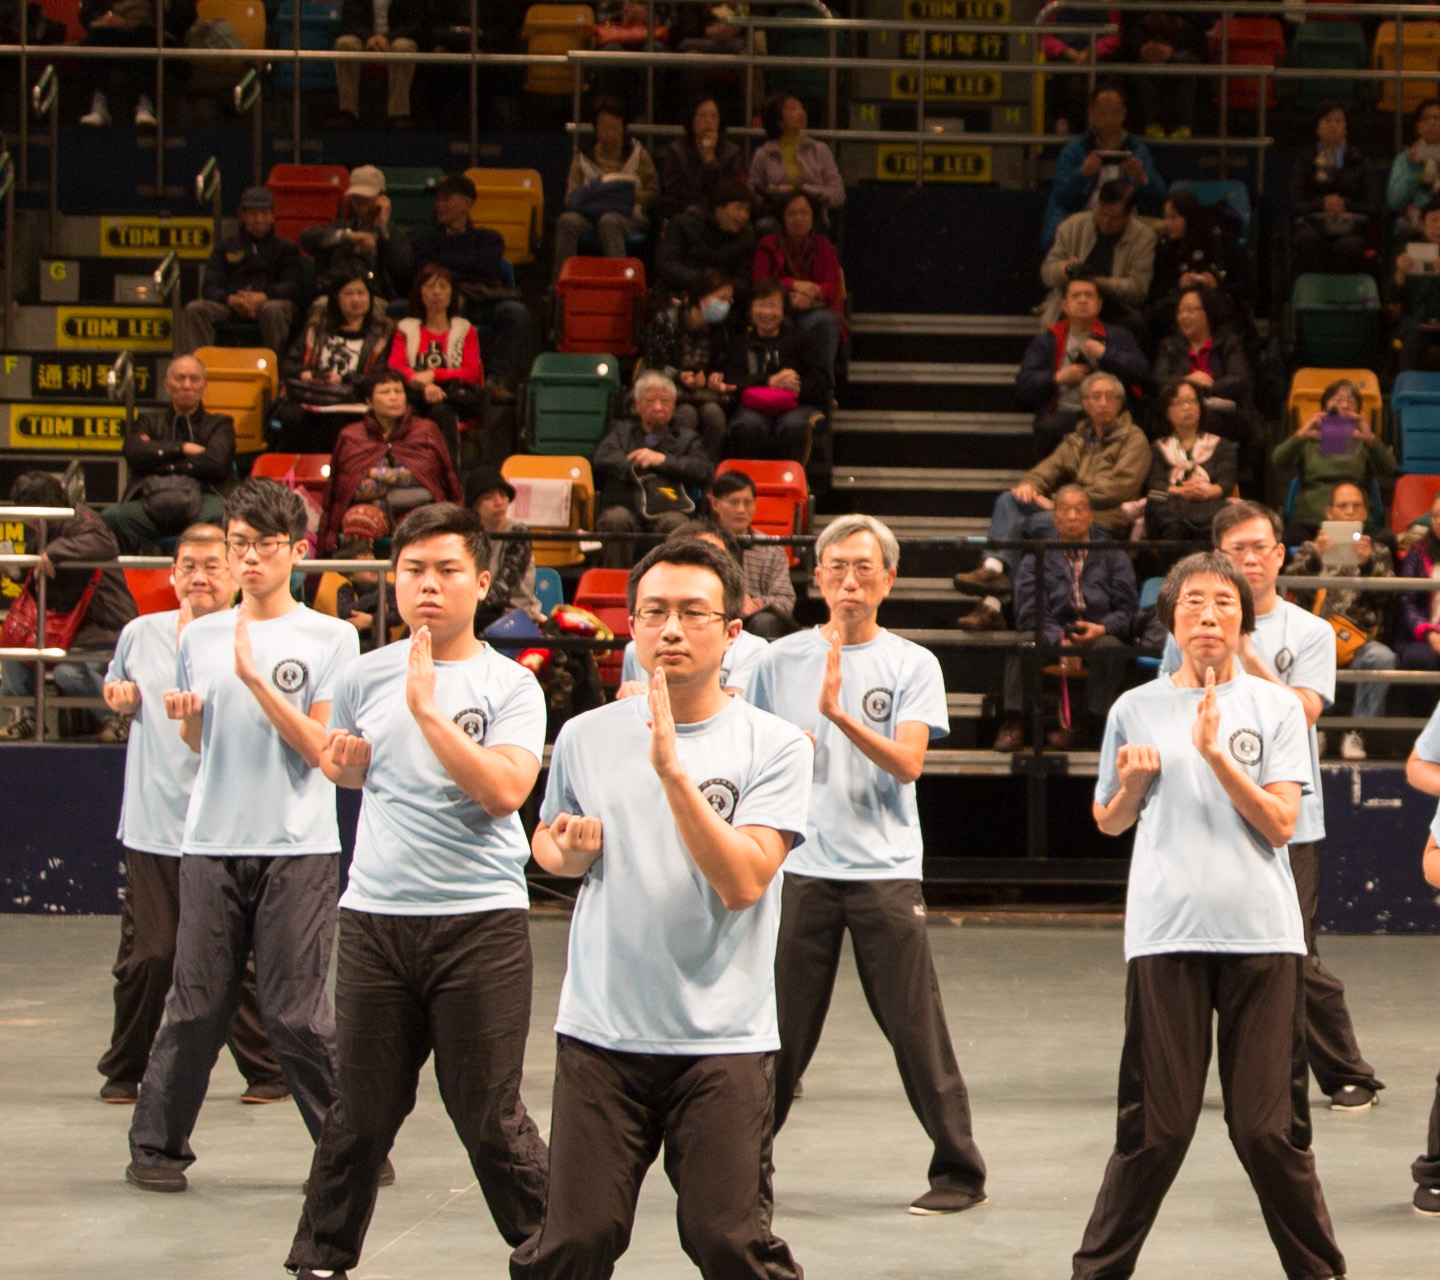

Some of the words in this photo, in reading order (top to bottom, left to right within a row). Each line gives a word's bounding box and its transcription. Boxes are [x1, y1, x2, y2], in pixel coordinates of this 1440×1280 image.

[117, 229, 160, 245] TOM
[171, 229, 205, 245] LEE
[48, 261, 67, 281] G
[75, 318, 119, 336] TOM
[129, 318, 164, 336] LEE
[3, 355, 19, 376] F
[28, 415, 74, 438] TOM
[82, 416, 122, 438] LEE
